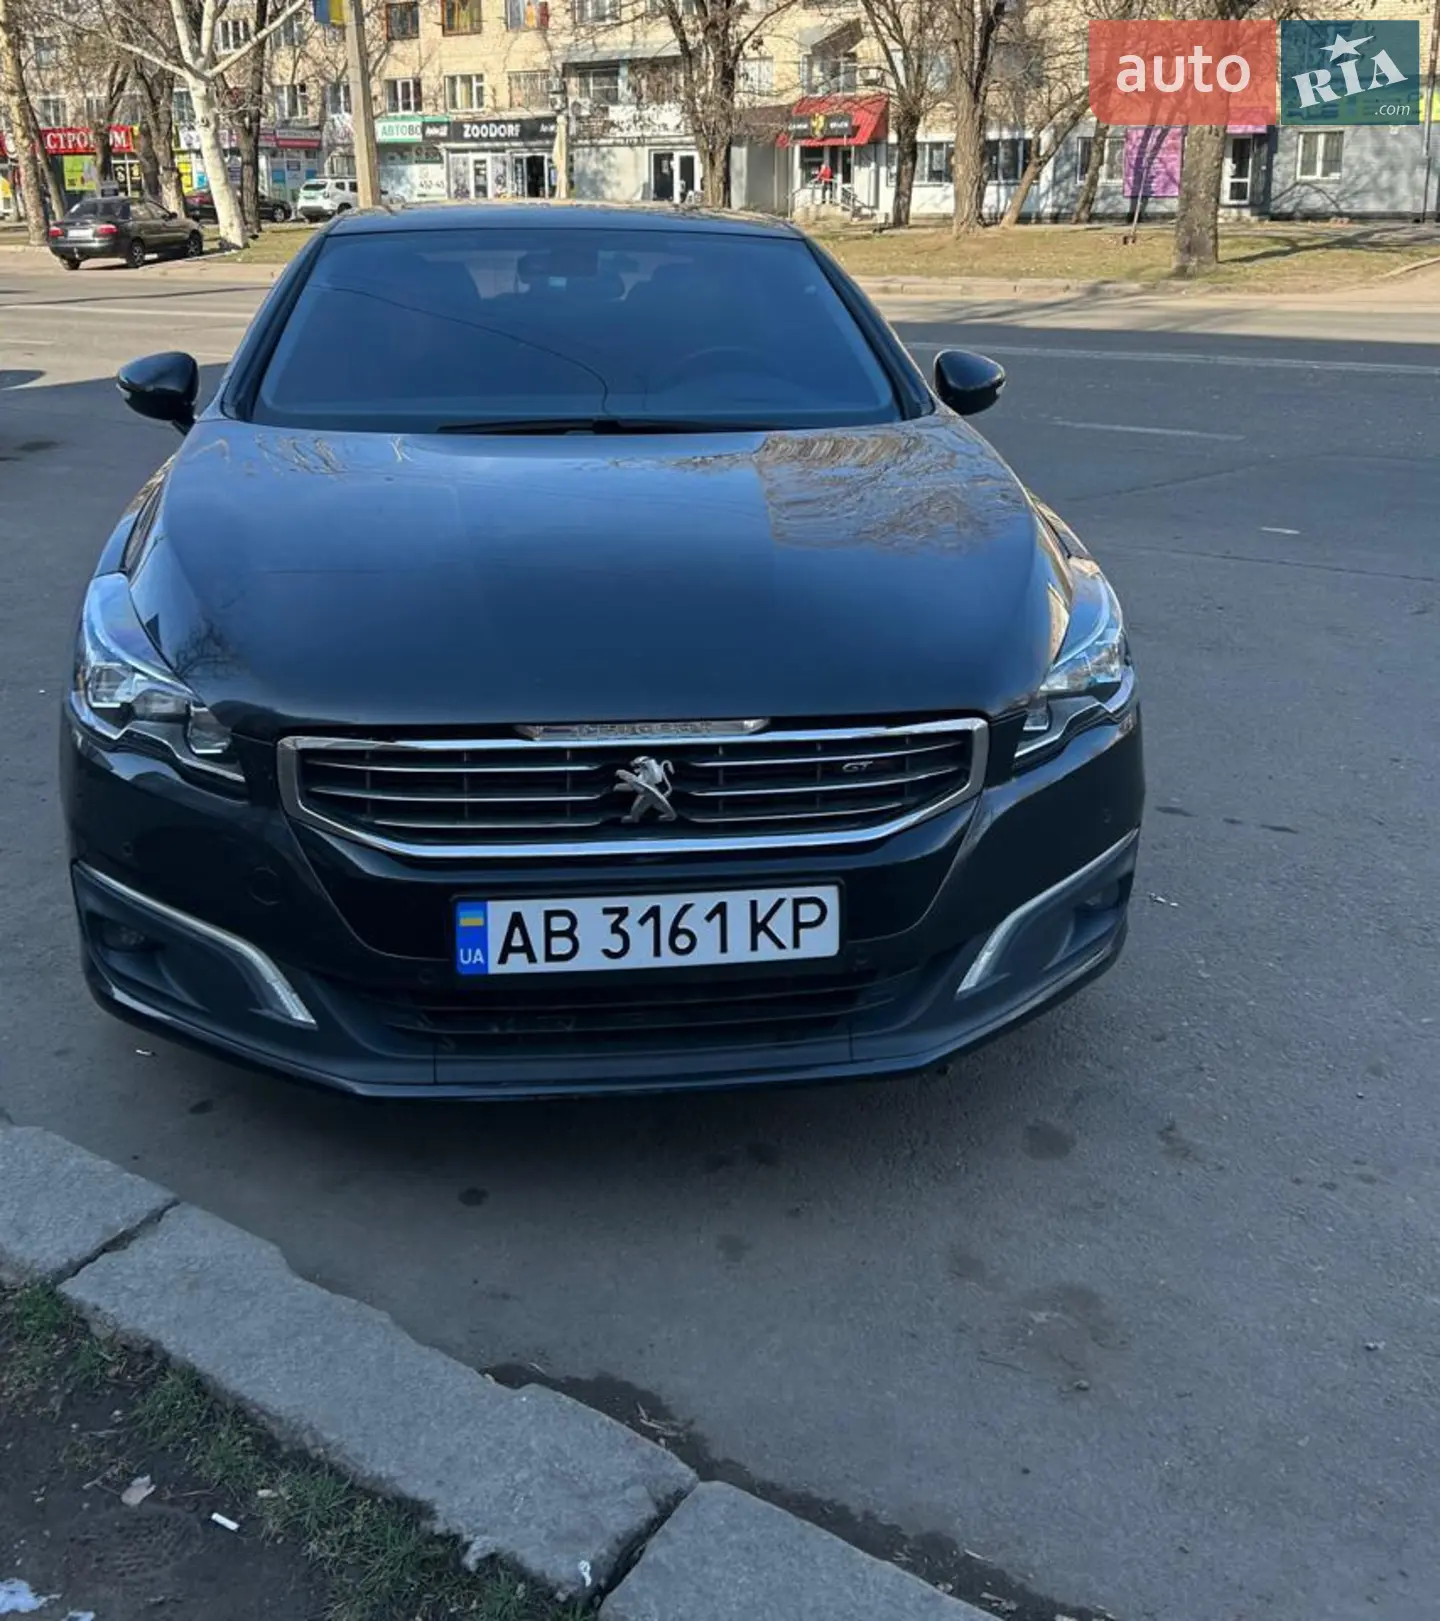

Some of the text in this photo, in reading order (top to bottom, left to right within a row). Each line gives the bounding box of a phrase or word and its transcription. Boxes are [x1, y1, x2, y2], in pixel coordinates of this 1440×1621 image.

[462, 123, 521, 139] ZOODORF
[496, 896, 828, 965] AB 3161 KP
[459, 948, 485, 965] UA
